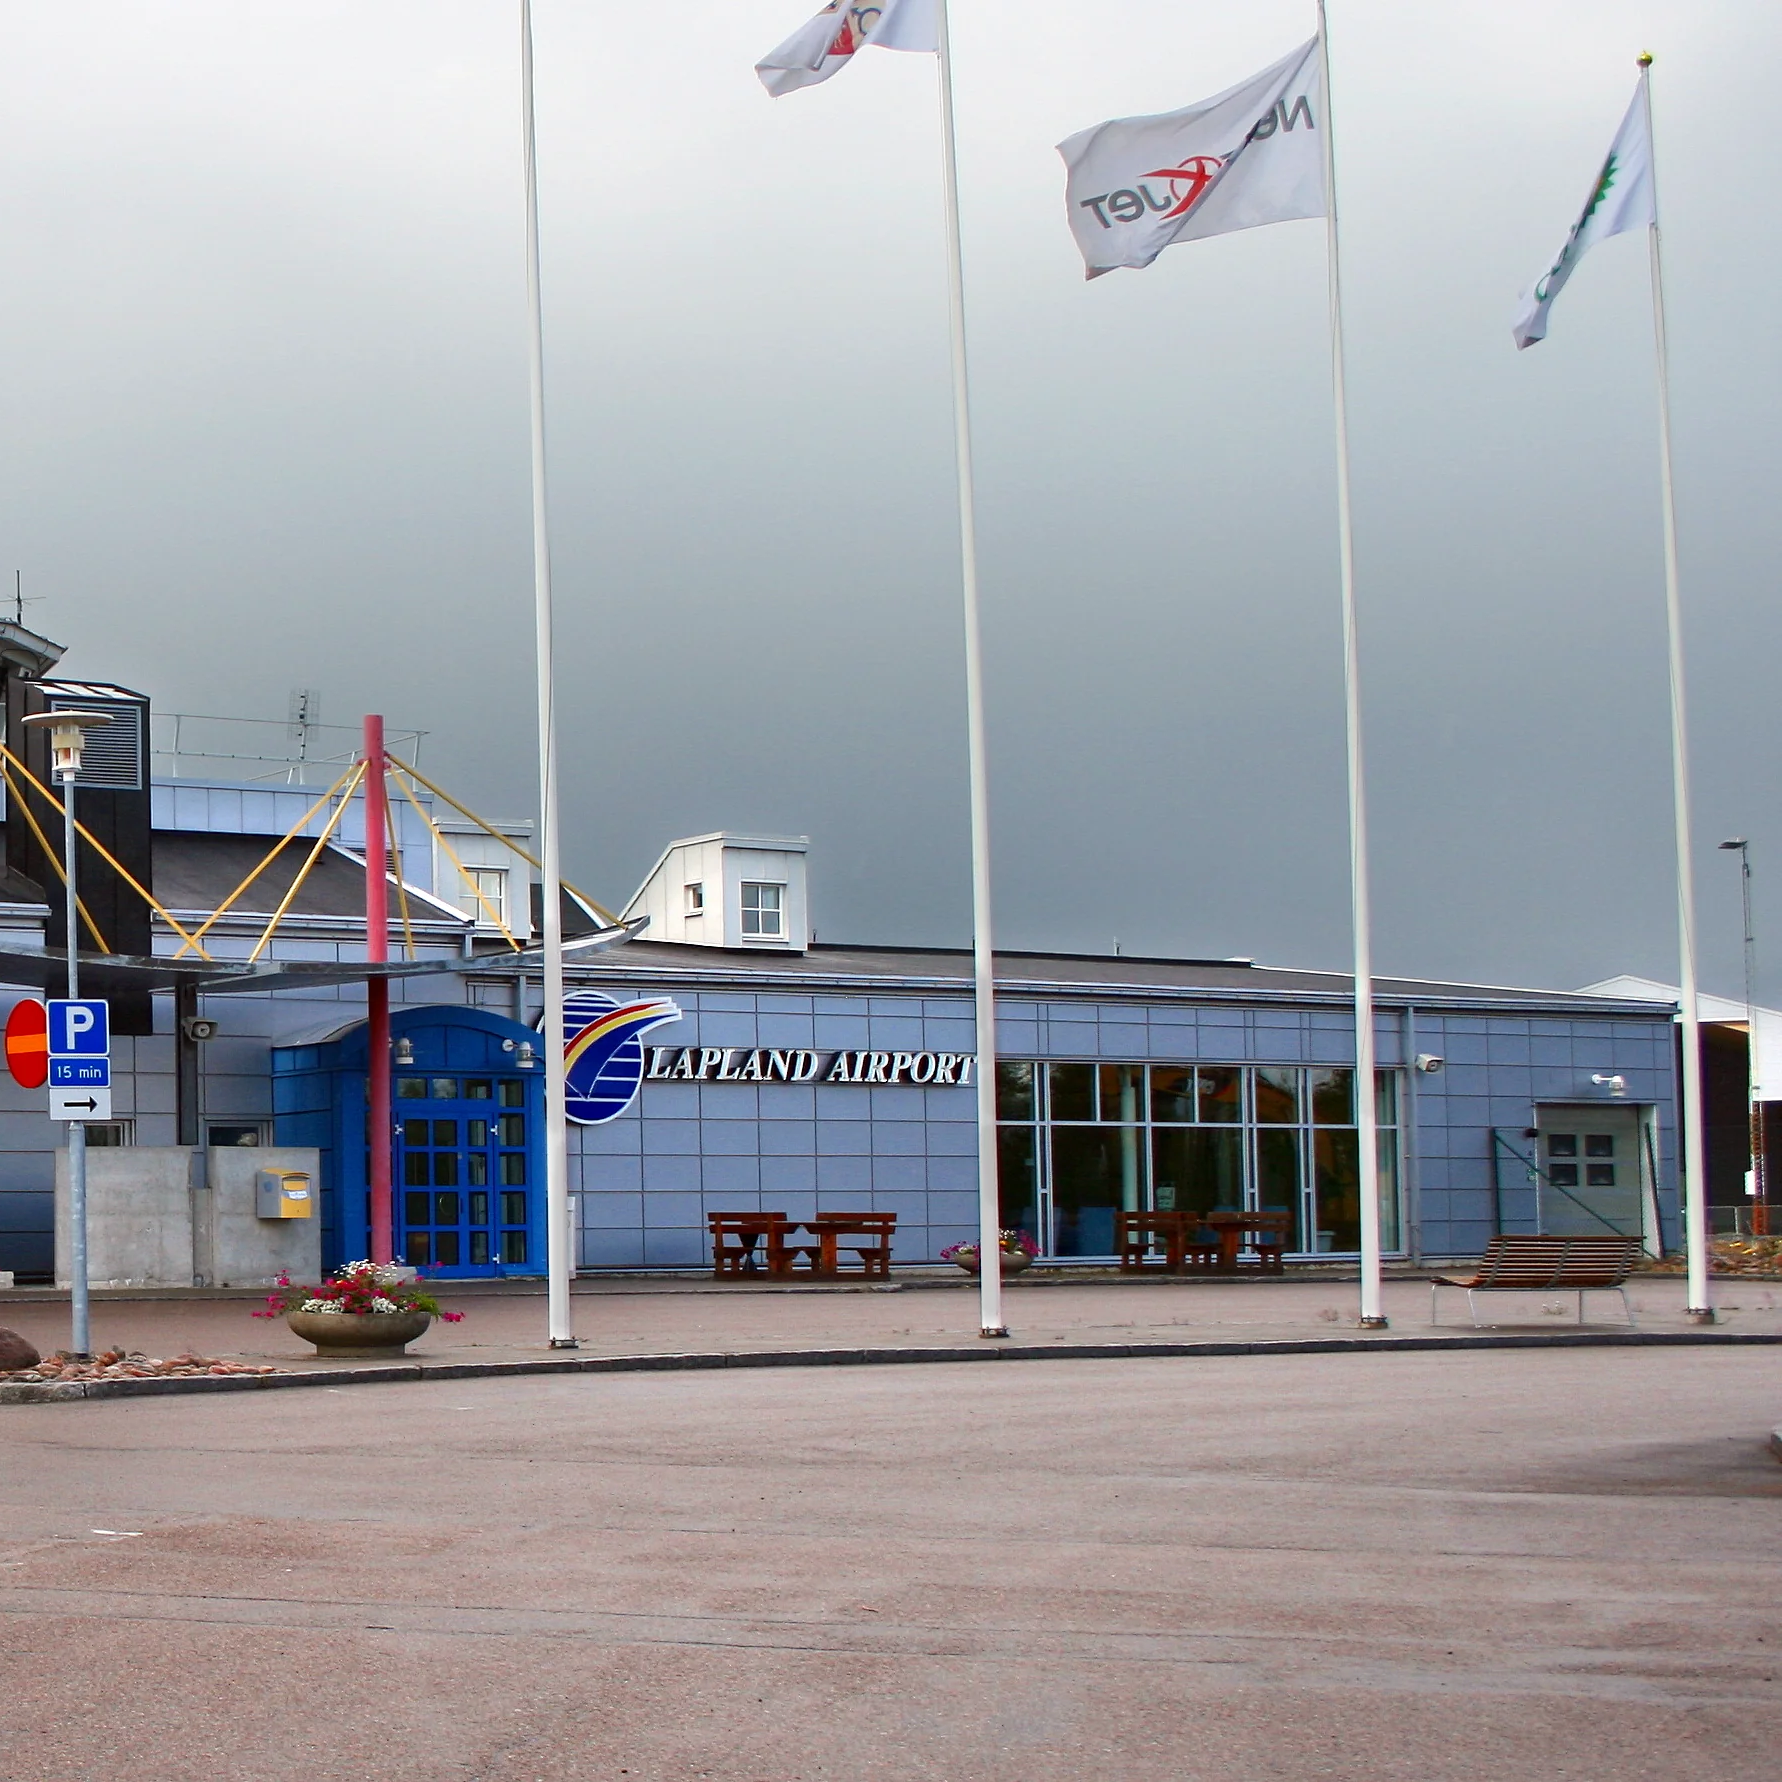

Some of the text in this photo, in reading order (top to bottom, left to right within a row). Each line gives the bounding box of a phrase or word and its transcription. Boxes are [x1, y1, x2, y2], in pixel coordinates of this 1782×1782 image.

[65, 1006, 95, 1050] P
[57, 1065, 102, 1079] 15 min
[646, 1046, 978, 1085] LAPLAND AIRPORT
